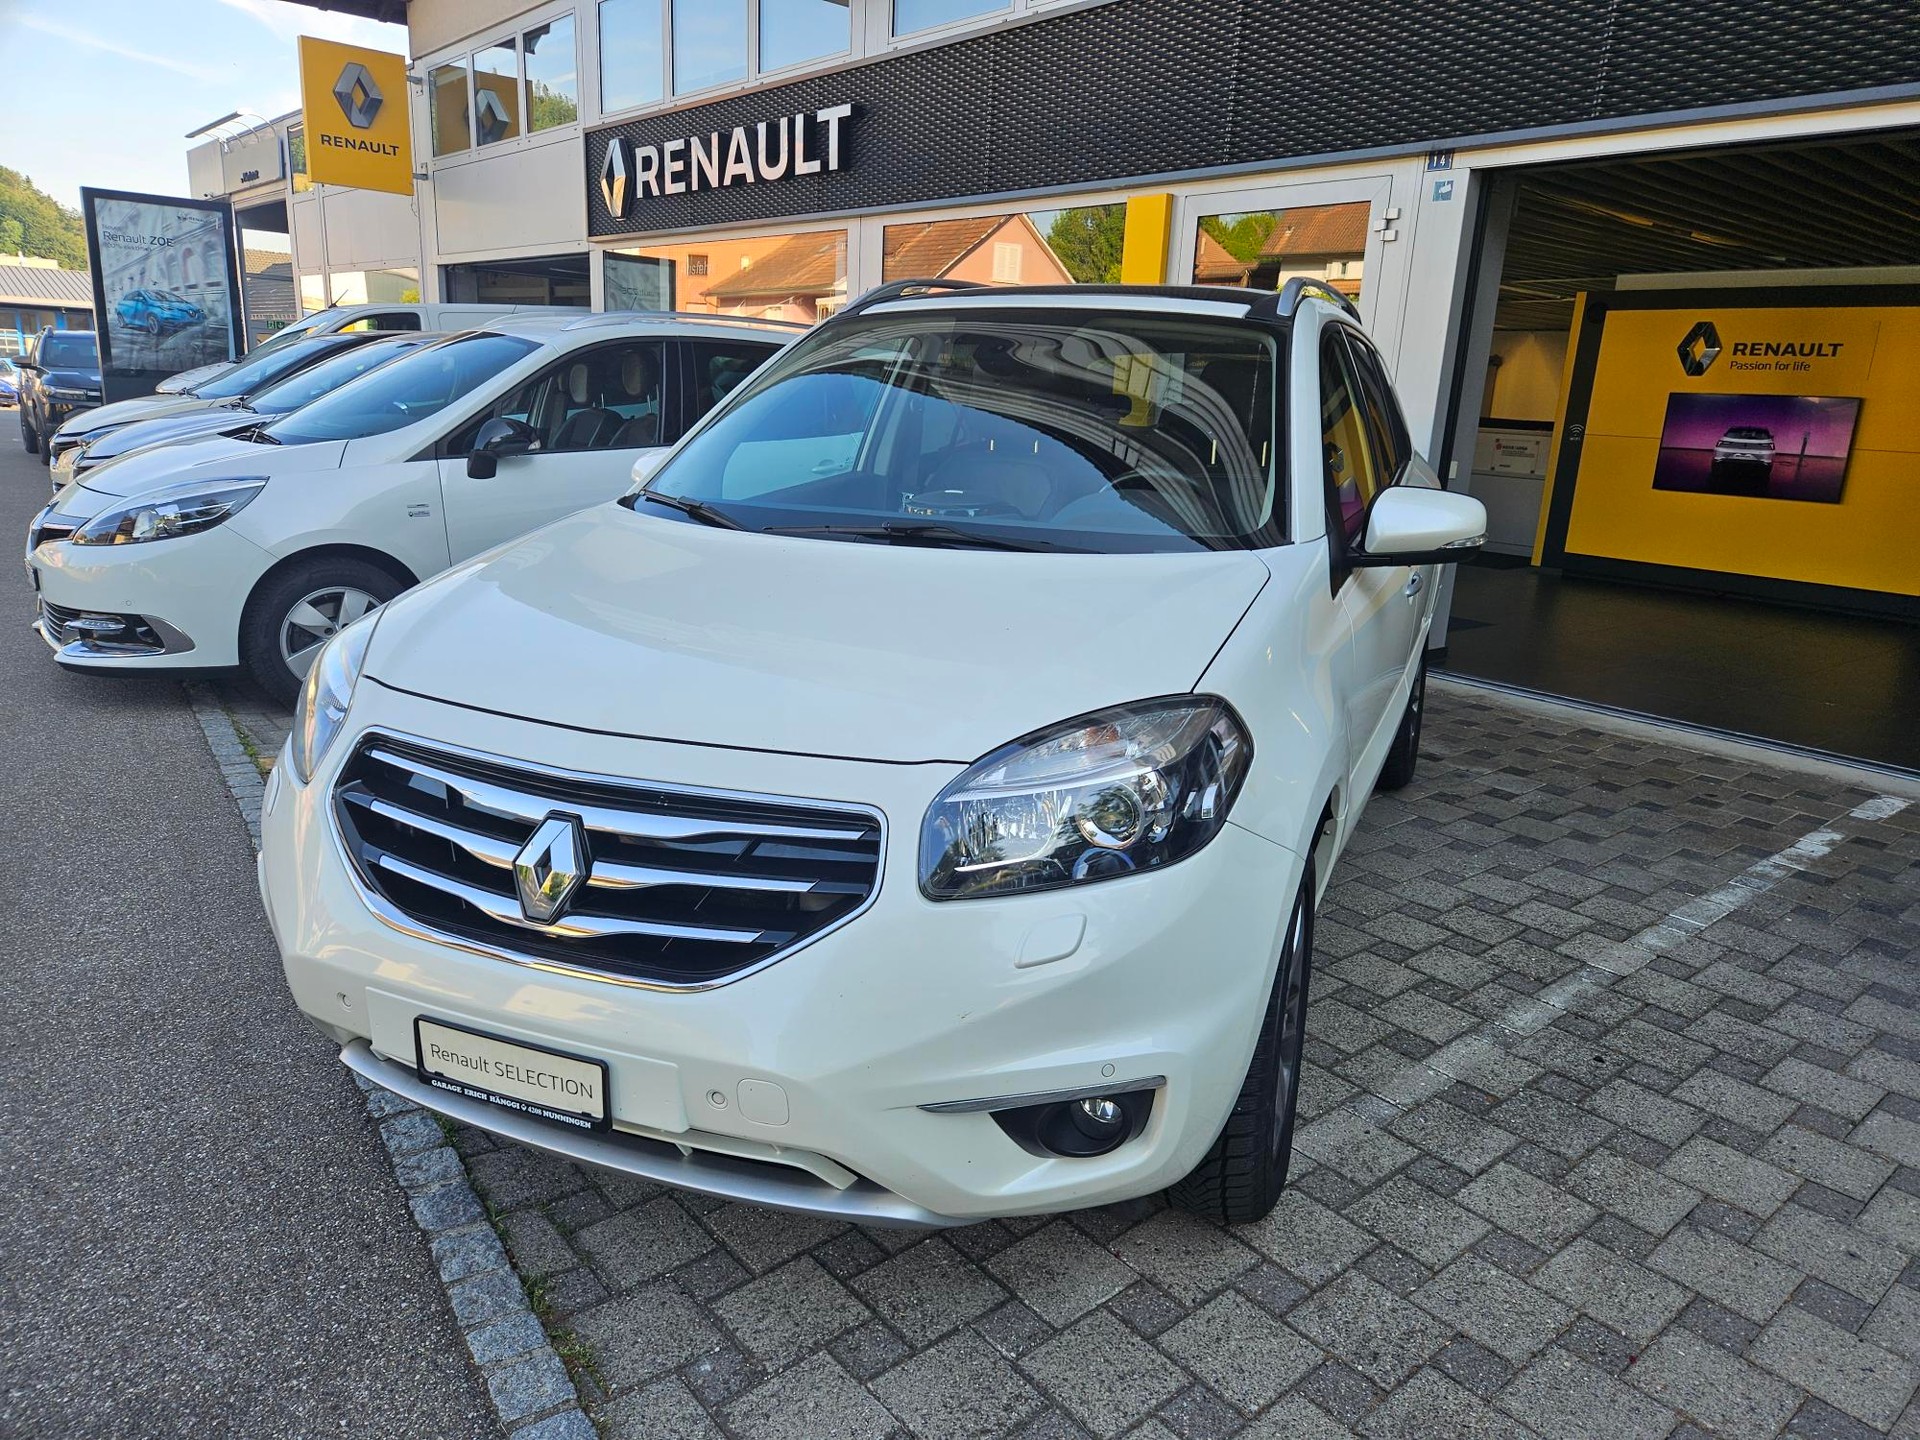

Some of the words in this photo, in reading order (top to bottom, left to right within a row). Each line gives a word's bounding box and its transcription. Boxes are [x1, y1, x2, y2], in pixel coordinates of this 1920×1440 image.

[319, 133, 400, 158] RENAULT
[635, 103, 852, 199] RENAULT
[1433, 155, 1446, 167] 14
[103, 230, 147, 245] Renault
[149, 235, 174, 248] ZOE
[1732, 342, 1844, 357] RENAULT
[1729, 360, 1771, 371] Passion
[1774, 361, 1790, 371] for
[1792, 361, 1811, 372] life
[429, 1042, 490, 1074] Renault
[494, 1061, 594, 1099] SELECTION
[431, 1079, 462, 1094] GARAGE
[464, 1088, 488, 1101] ERICH
[489, 1095, 520, 1110] HÄNGGI
[543, 1110, 592, 1129] NUNNINGEN
